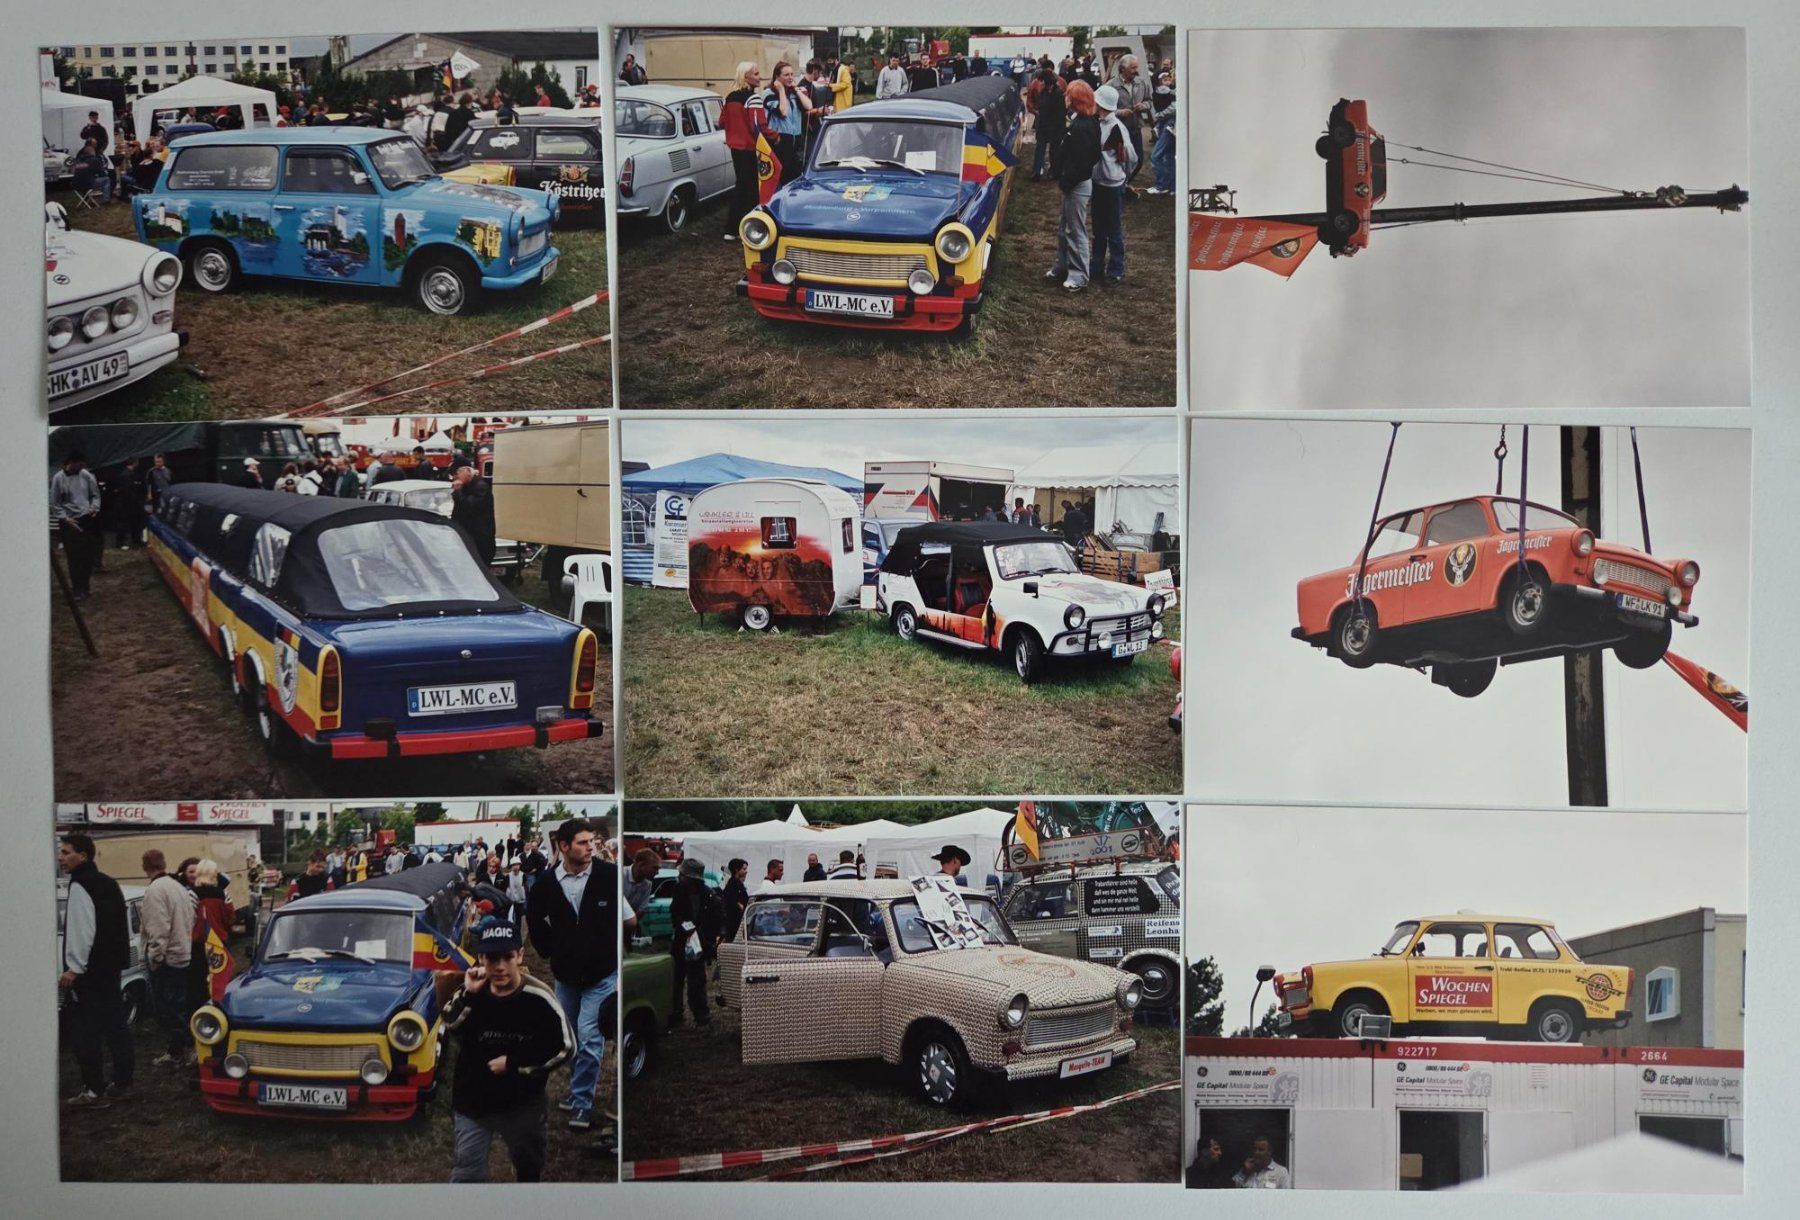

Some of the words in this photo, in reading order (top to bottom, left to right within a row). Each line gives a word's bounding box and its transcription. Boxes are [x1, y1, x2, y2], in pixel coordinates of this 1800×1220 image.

[815, 294, 867, 312] LWL-MC
[870, 299, 892, 314] e.V.
[48, 371, 71, 394] HK
[82, 363, 99, 386] AV
[103, 358, 119, 377] 49
[421, 688, 484, 707] LWL-MC
[489, 686, 514, 704] e.V.
[482, 927, 513, 939] MAGIC
[1431, 977, 1491, 993] WOCHEN
[1418, 989, 1468, 1005] SPIEGEL
[1397, 1047, 1438, 1057] 922717
[1641, 1051, 1668, 1061] 2664
[1206, 1082, 1228, 1090] Capital
[1660, 1075, 1670, 1085] GE
[1670, 1076, 1693, 1087] Capital
[268, 1087, 319, 1104] LWL-MC
[323, 1091, 345, 1105] e.V.
